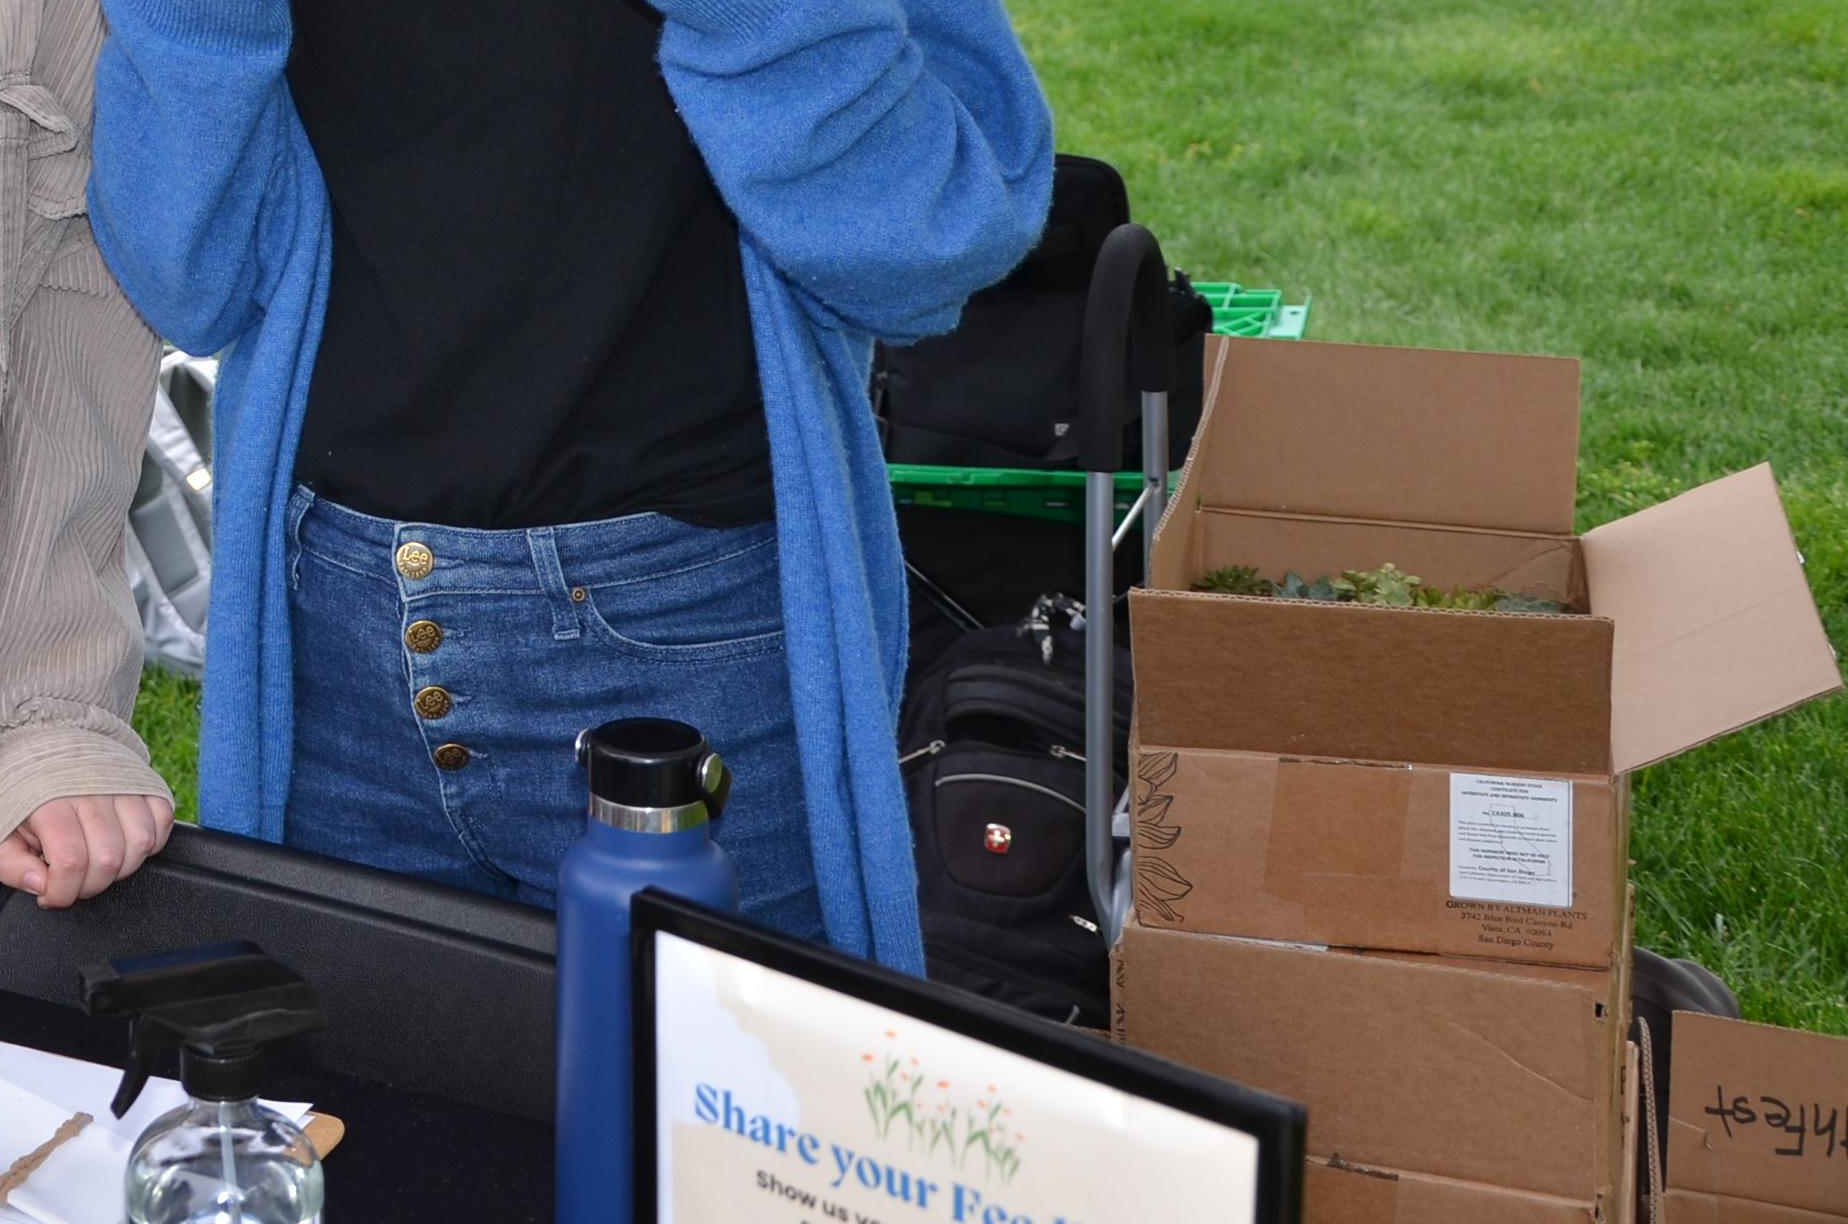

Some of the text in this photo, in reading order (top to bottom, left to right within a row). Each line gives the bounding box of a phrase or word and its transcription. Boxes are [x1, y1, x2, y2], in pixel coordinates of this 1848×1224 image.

[402, 545, 429, 565] Lee
[408, 626, 436, 643] Lee
[416, 691, 444, 710] Lee
[1446, 900, 1485, 910] GROWN
[1496, 935, 1522, 947] Diego
[1523, 938, 1554, 951] County
[694, 1083, 820, 1165] Share
[829, 1142, 939, 1212] your
[756, 1169, 850, 1223] Show us
